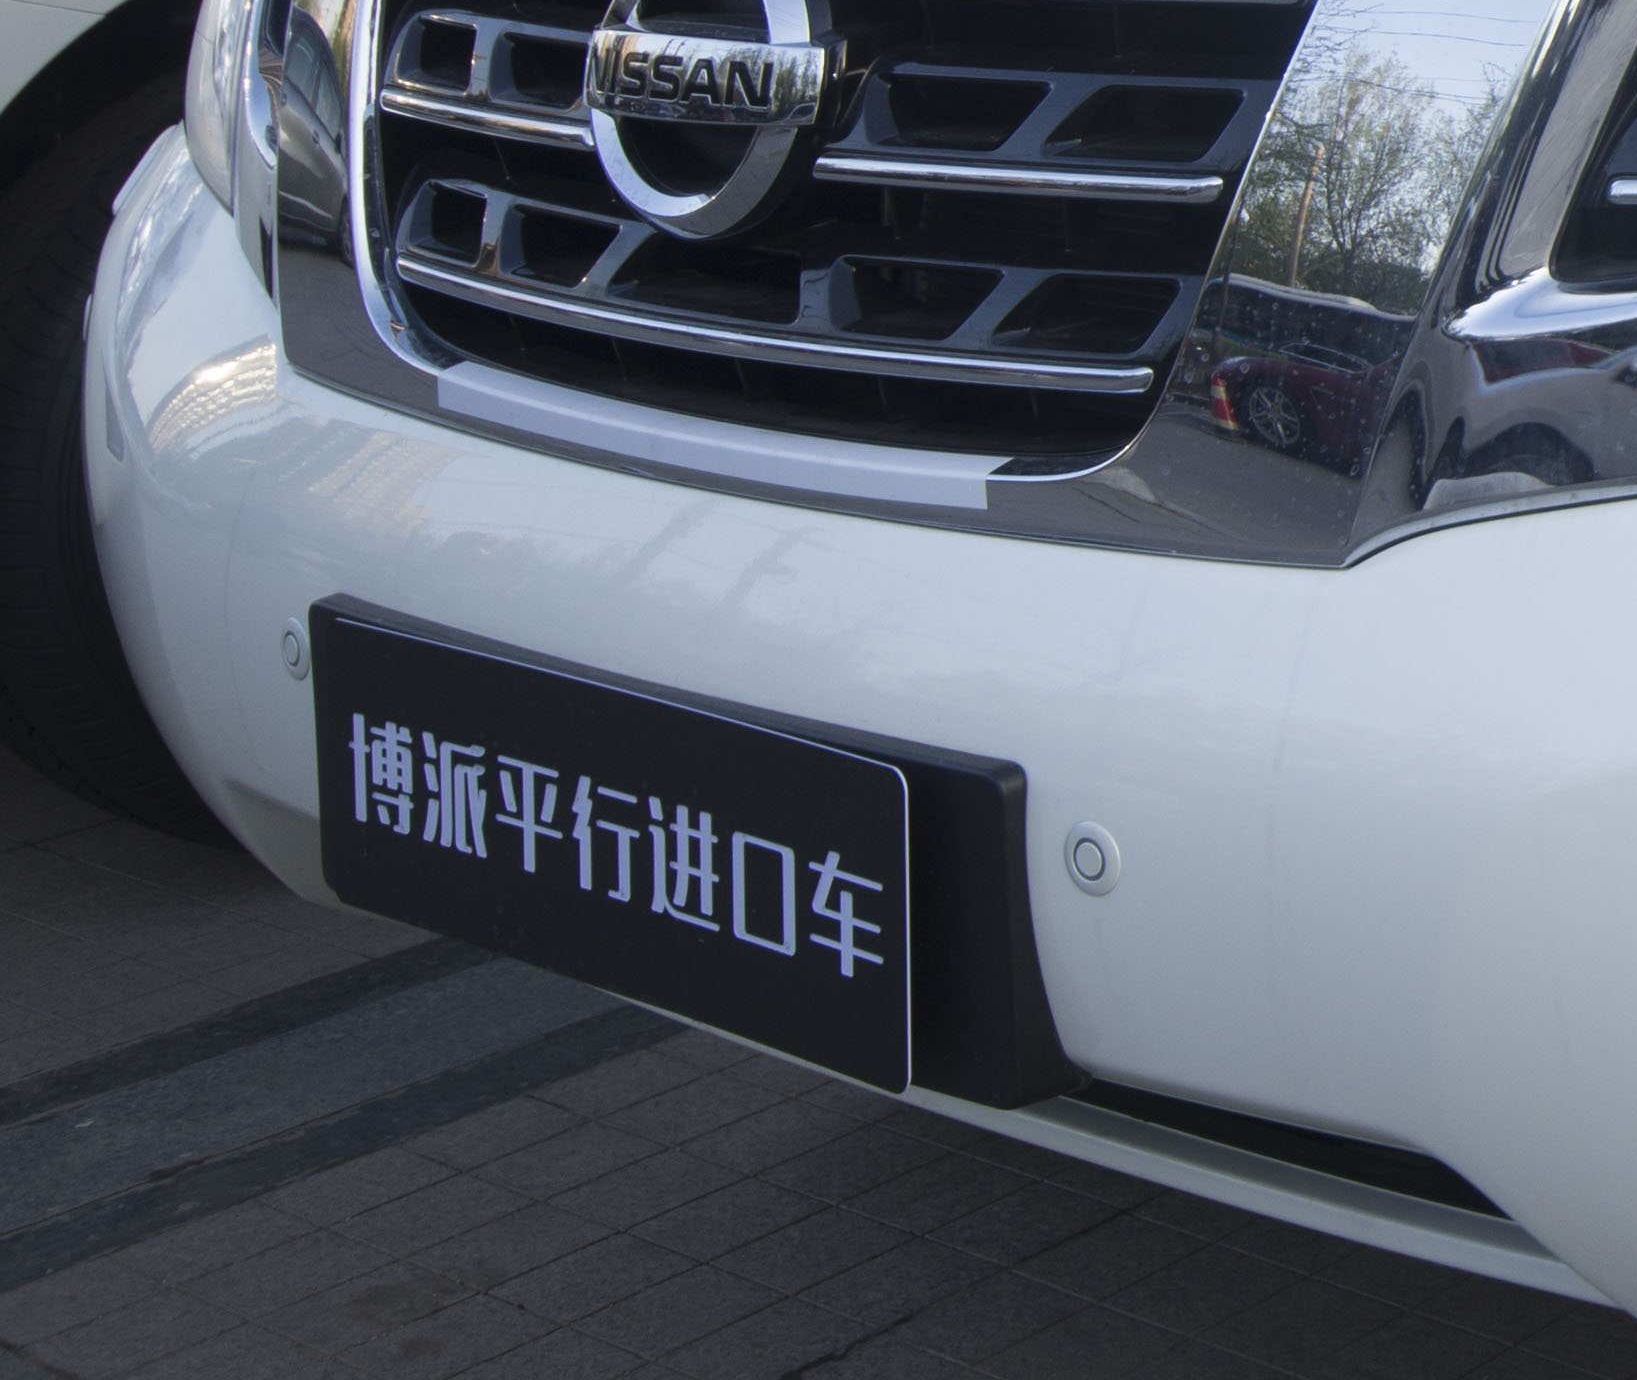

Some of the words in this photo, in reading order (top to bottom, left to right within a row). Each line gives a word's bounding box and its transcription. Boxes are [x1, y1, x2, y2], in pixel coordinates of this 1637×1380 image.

[348, 712, 885, 978] 博派平行进口车
